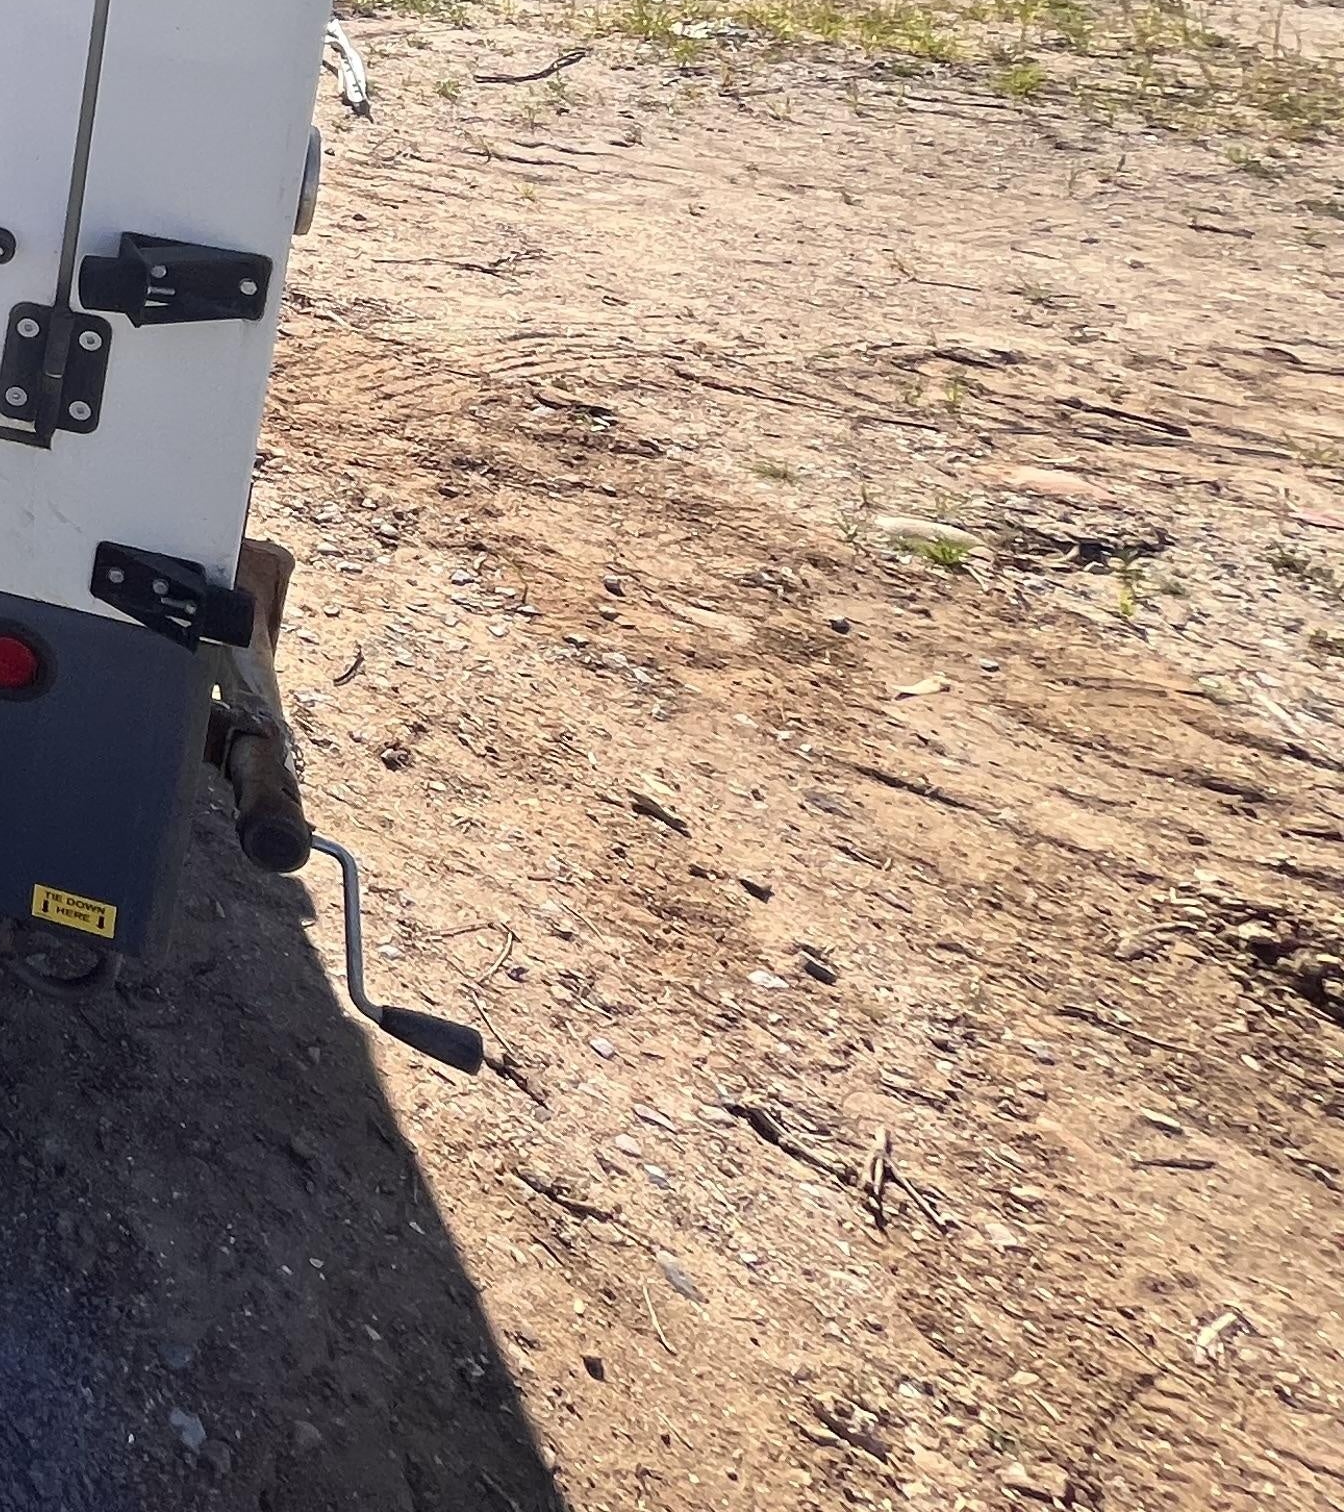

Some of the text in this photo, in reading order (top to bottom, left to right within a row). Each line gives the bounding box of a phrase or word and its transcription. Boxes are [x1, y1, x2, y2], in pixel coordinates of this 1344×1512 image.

[45, 891, 105, 914] TIE DOWN
[56, 906, 90, 922] HERE
